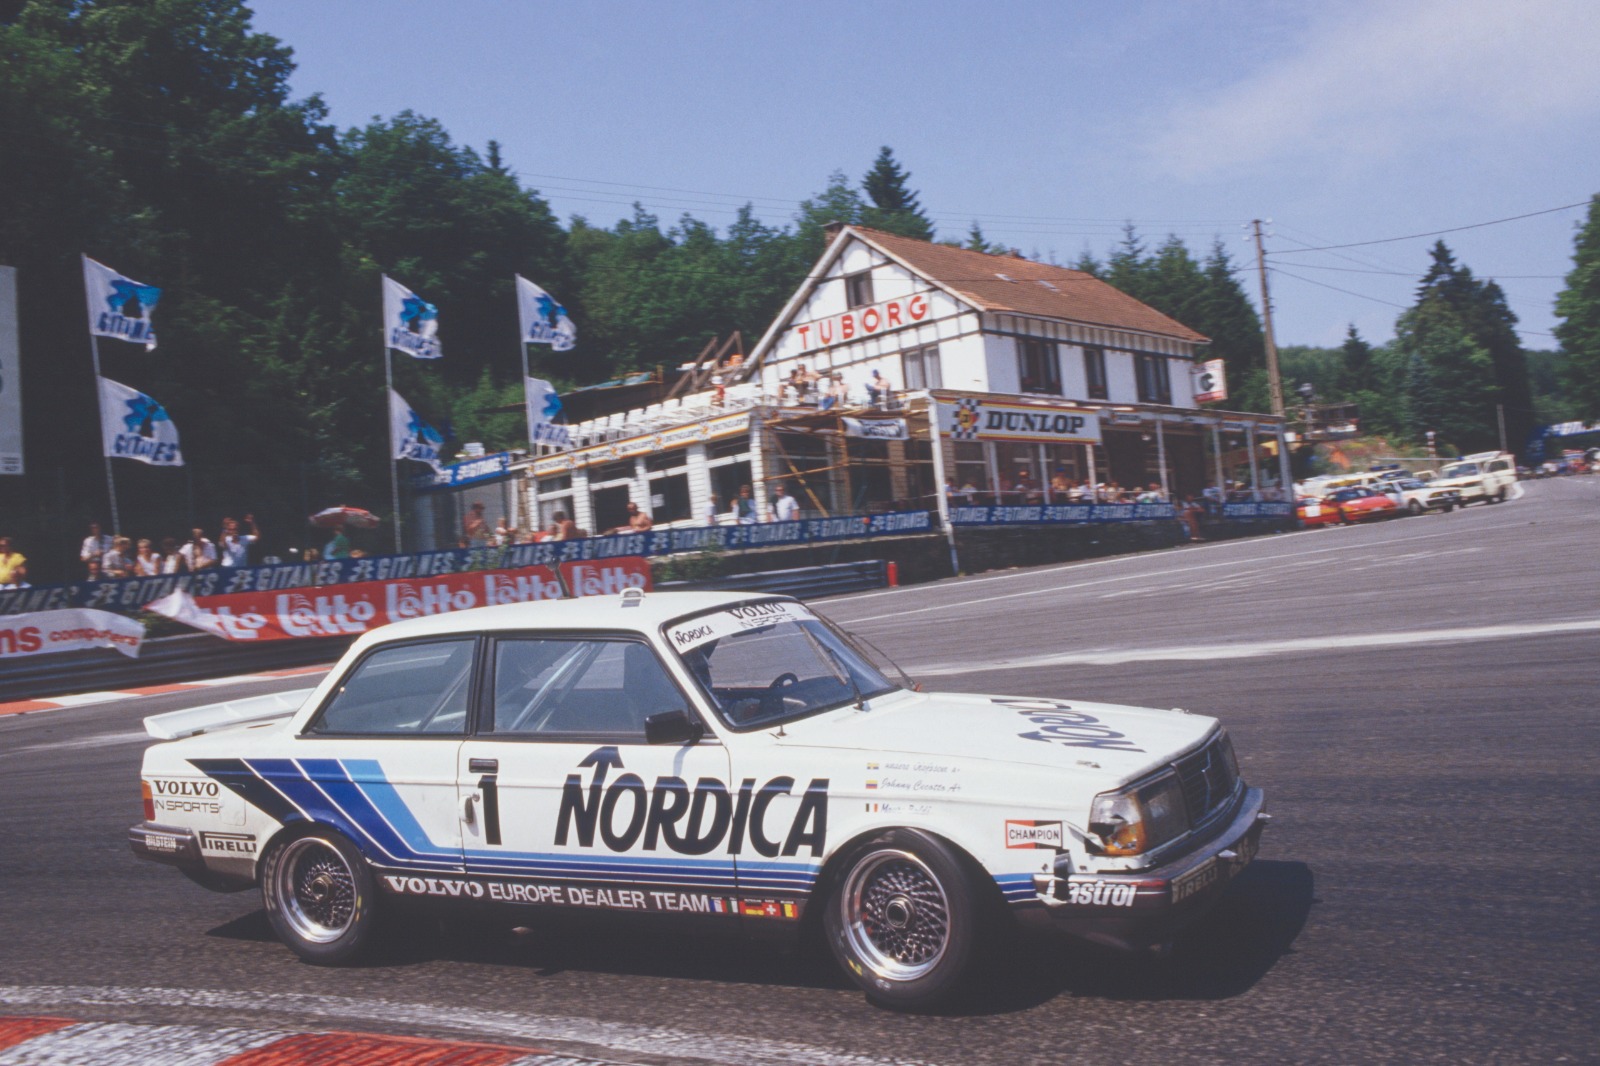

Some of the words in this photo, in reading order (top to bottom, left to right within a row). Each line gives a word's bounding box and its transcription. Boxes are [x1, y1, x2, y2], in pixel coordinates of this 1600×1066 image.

[797, 296, 928, 350] TUBORG
[985, 410, 1085, 434] DUNLOP
[115, 434, 178, 462] GITANES
[885, 511, 930, 531] GITANES
[582, 535, 645, 562] GITANES
[256, 562, 343, 592] GITANES
[725, 602, 787, 620] VOLVO
[674, 625, 715, 646] NORDICA
[153, 780, 219, 797] VOLVO
[155, 800, 165, 810] IN
[166, 800, 220, 814] SPORTS
[477, 774, 502, 846] 1
[553, 746, 831, 858] NORDICA
[145, 834, 177, 849] BILSTEIN
[198, 831, 257, 853] PIRELLI
[1008, 829, 1060, 841] CHAMPION
[383, 875, 484, 898] VOLVO
[487, 882, 565, 904] EUROPE
[567, 887, 647, 909] DEALER
[649, 891, 711, 913] TEAM
